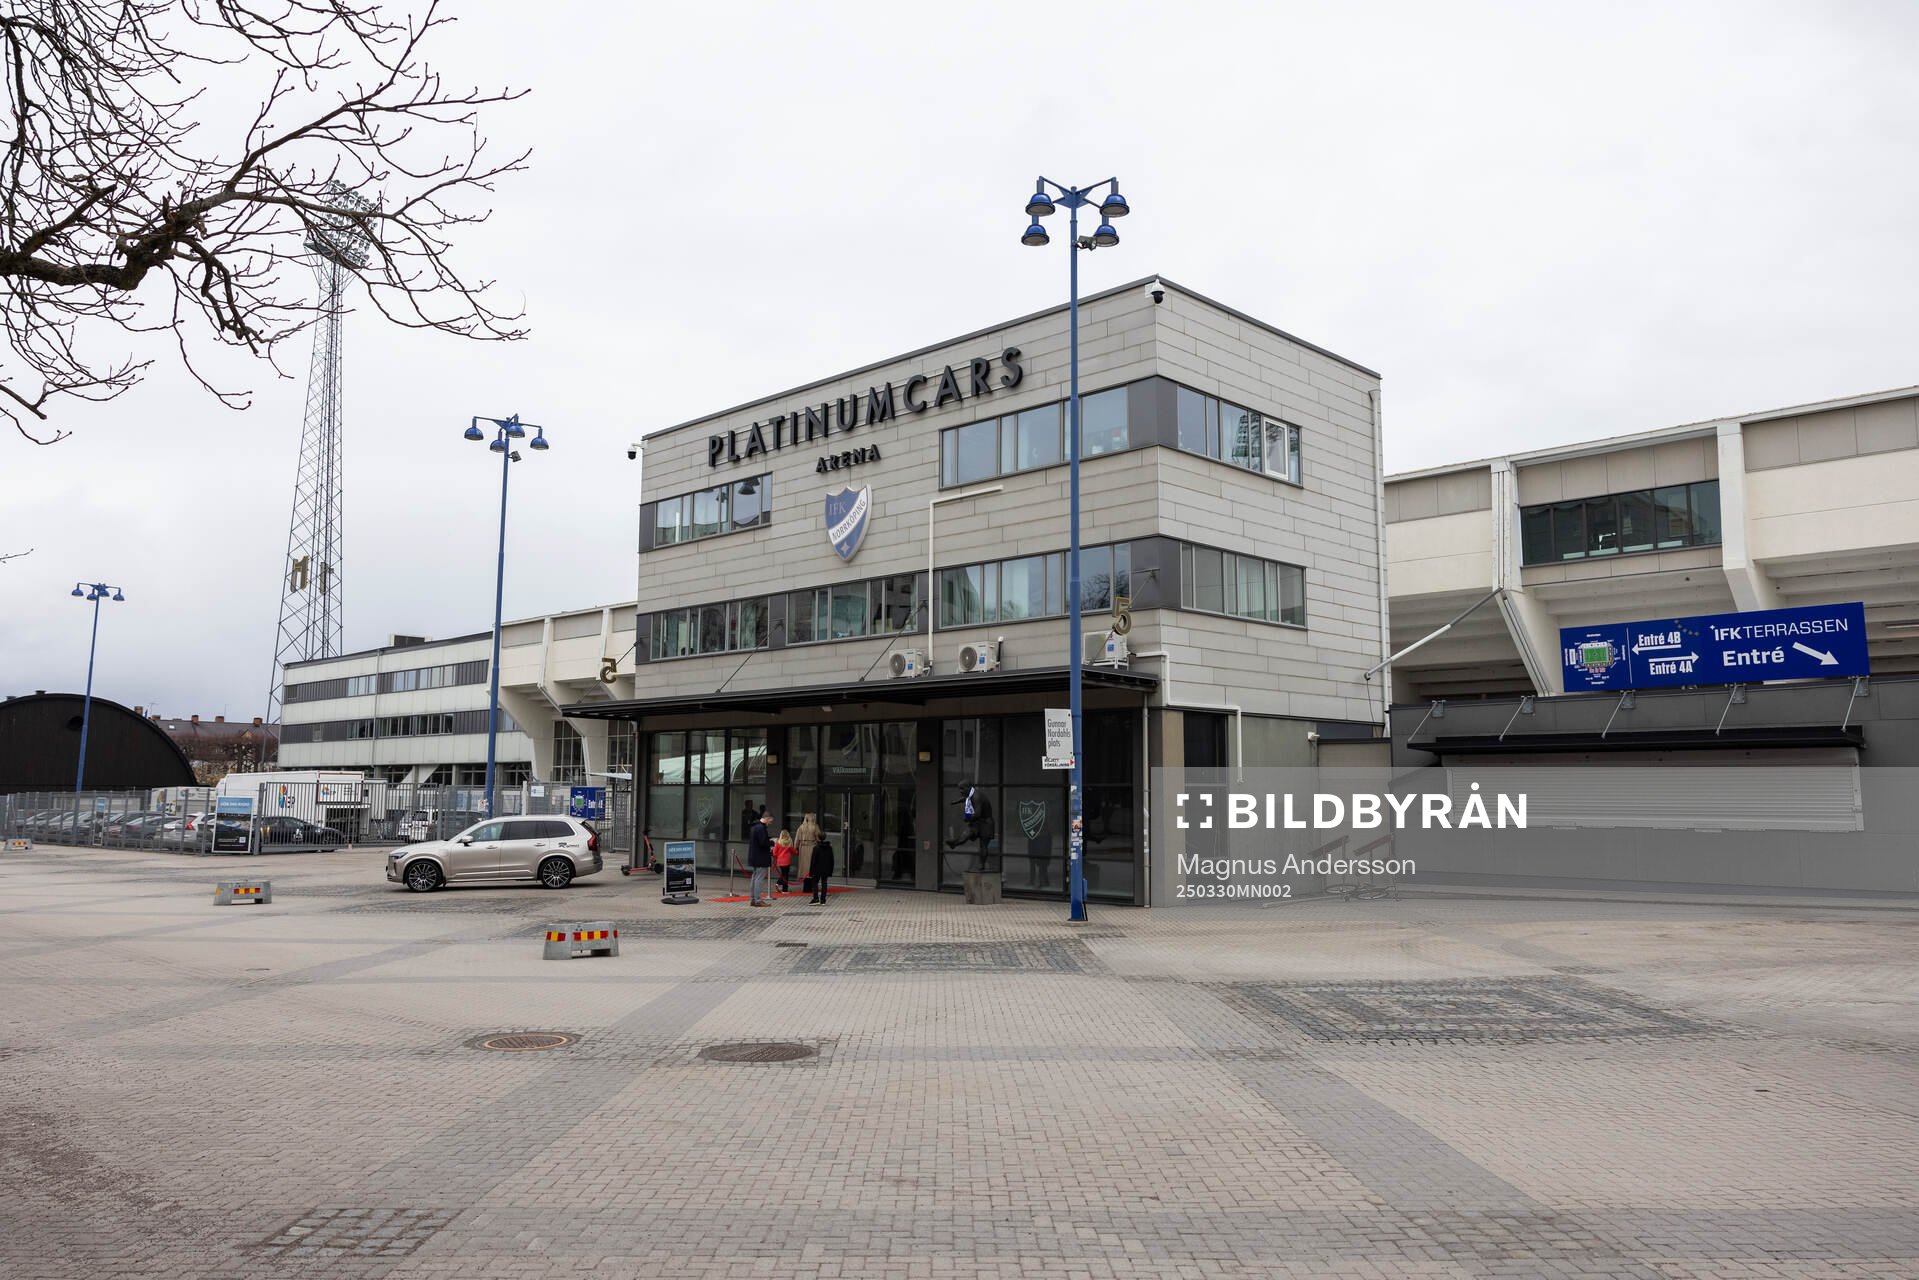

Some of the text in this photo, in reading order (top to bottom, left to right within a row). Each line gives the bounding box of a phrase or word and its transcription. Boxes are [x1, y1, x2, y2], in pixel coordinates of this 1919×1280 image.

[708, 347, 1024, 467] PLATINUMCARS
[815, 443, 882, 473] ARENA
[829, 502, 846, 516] IFK
[1111, 596, 1131, 635] 5
[1638, 631, 1682, 647] Entré 4B
[1723, 647, 1785, 667] Entré
[1650, 660, 1693, 676] Entré 4A
[1047, 718, 1067, 728] Gunnar
[1047, 728, 1072, 738] Nordahls
[1048, 738, 1061, 749] plats
